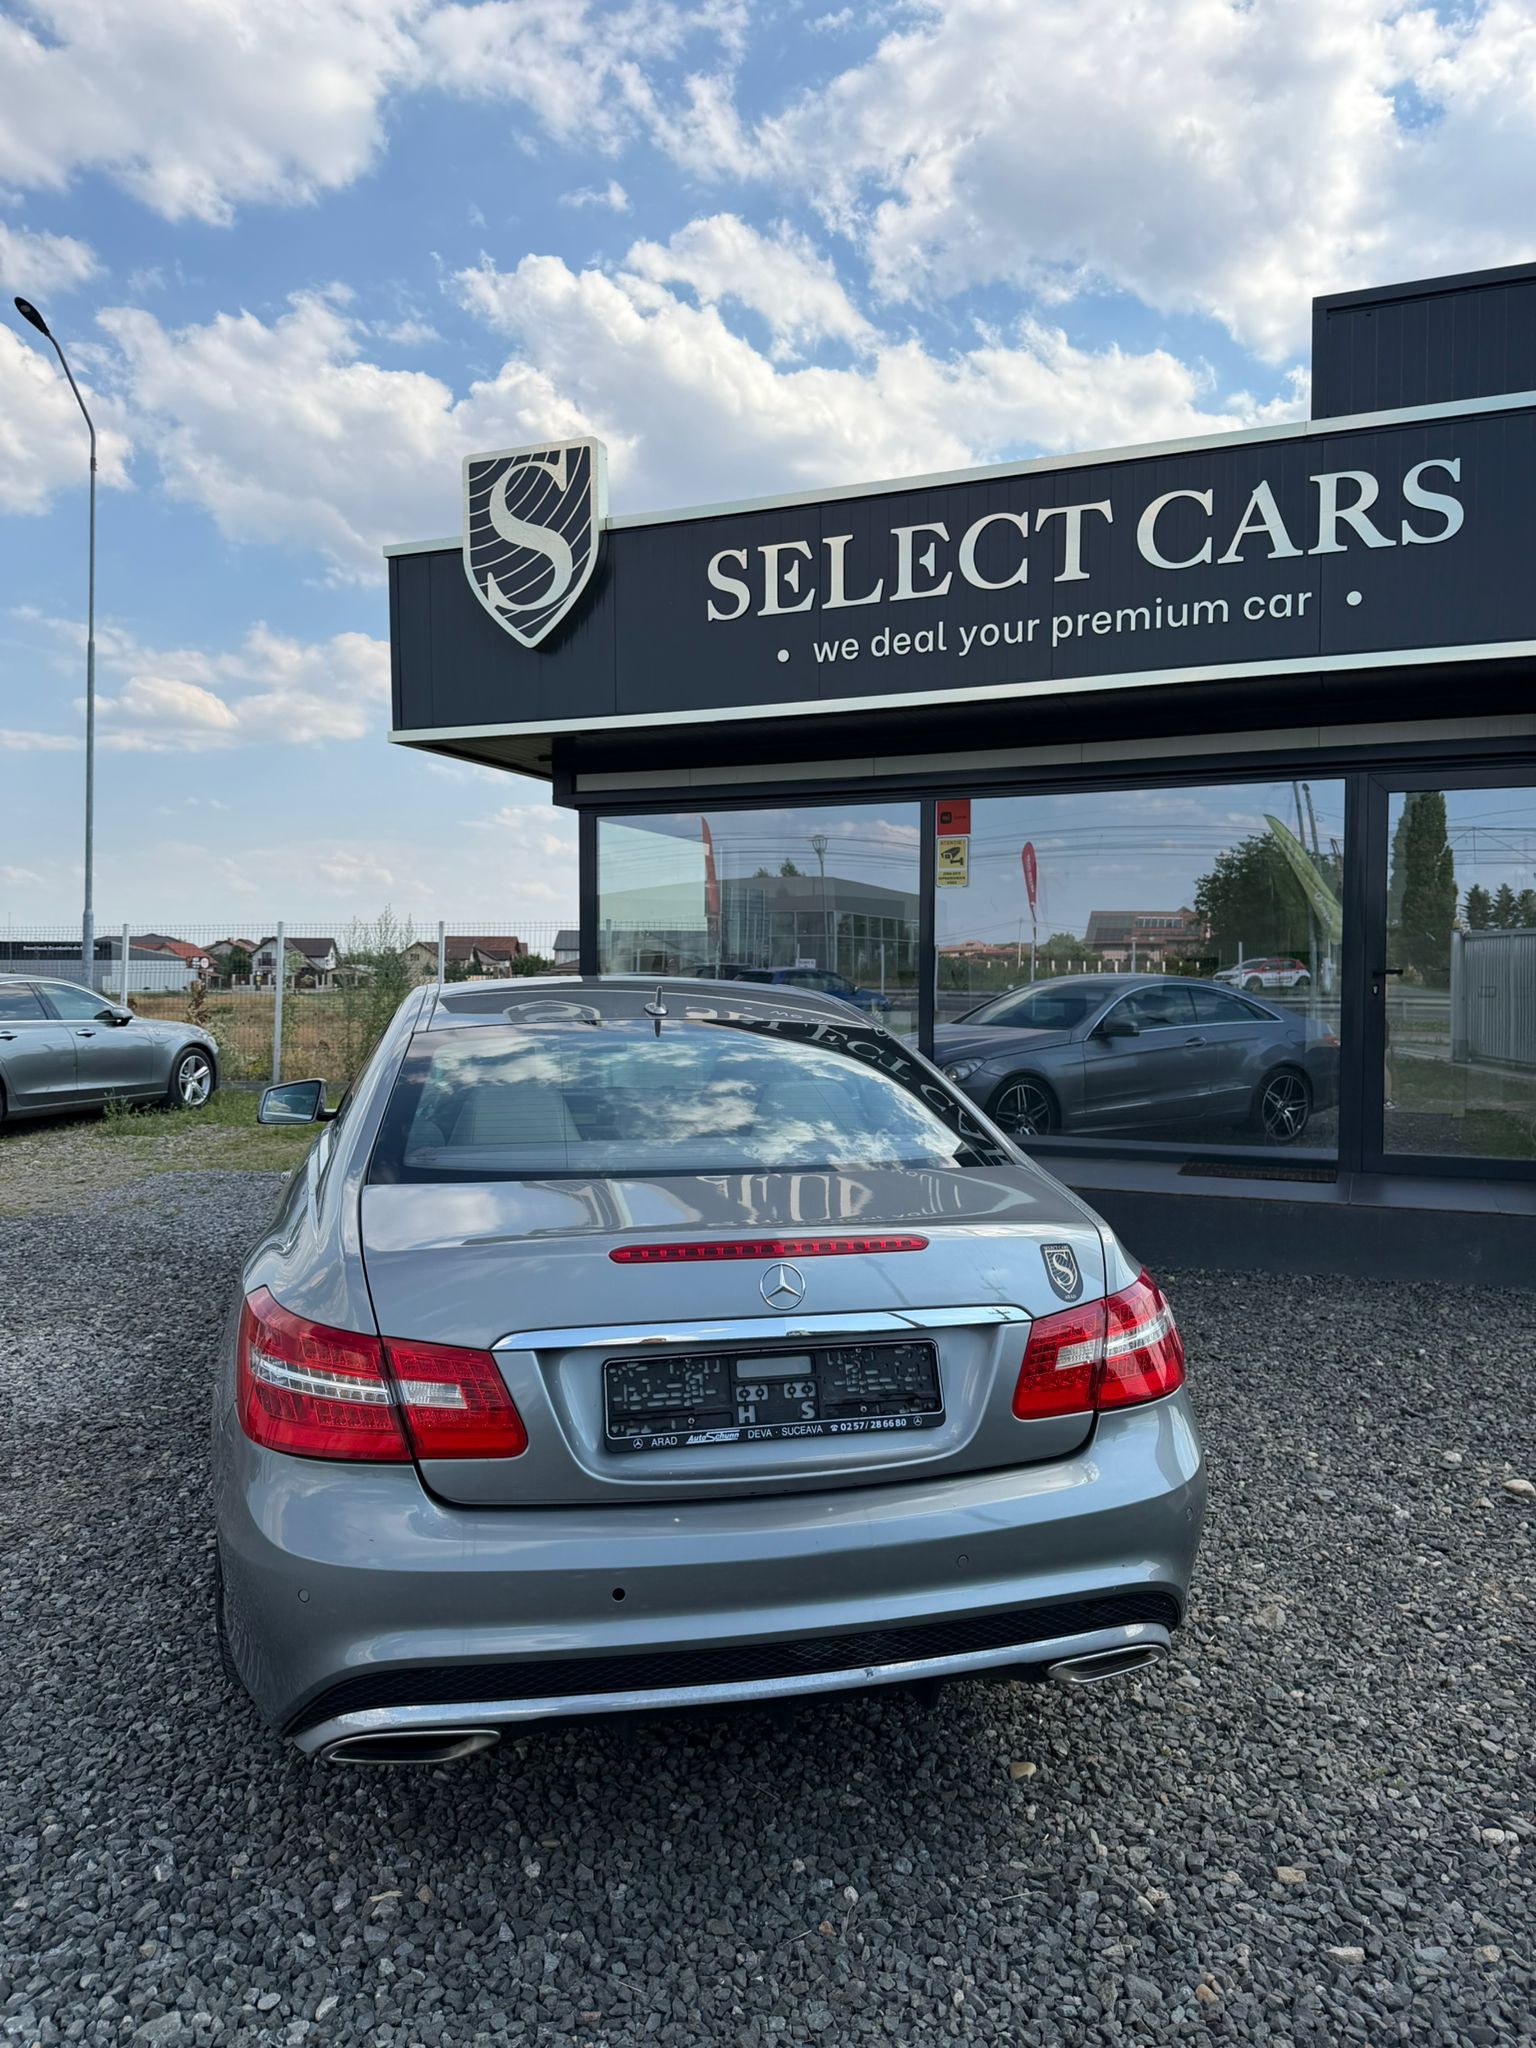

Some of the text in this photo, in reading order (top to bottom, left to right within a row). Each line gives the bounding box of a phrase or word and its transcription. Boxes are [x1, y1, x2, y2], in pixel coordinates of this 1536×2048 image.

[706, 457, 1466, 622] SELECT CARS
[813, 591, 1313, 663] we deal your premium car
[651, 1436, 678, 1447] ARAD
[747, 1429, 773, 1439] DEVA
[781, 1425, 823, 1436] SUCEAVA
